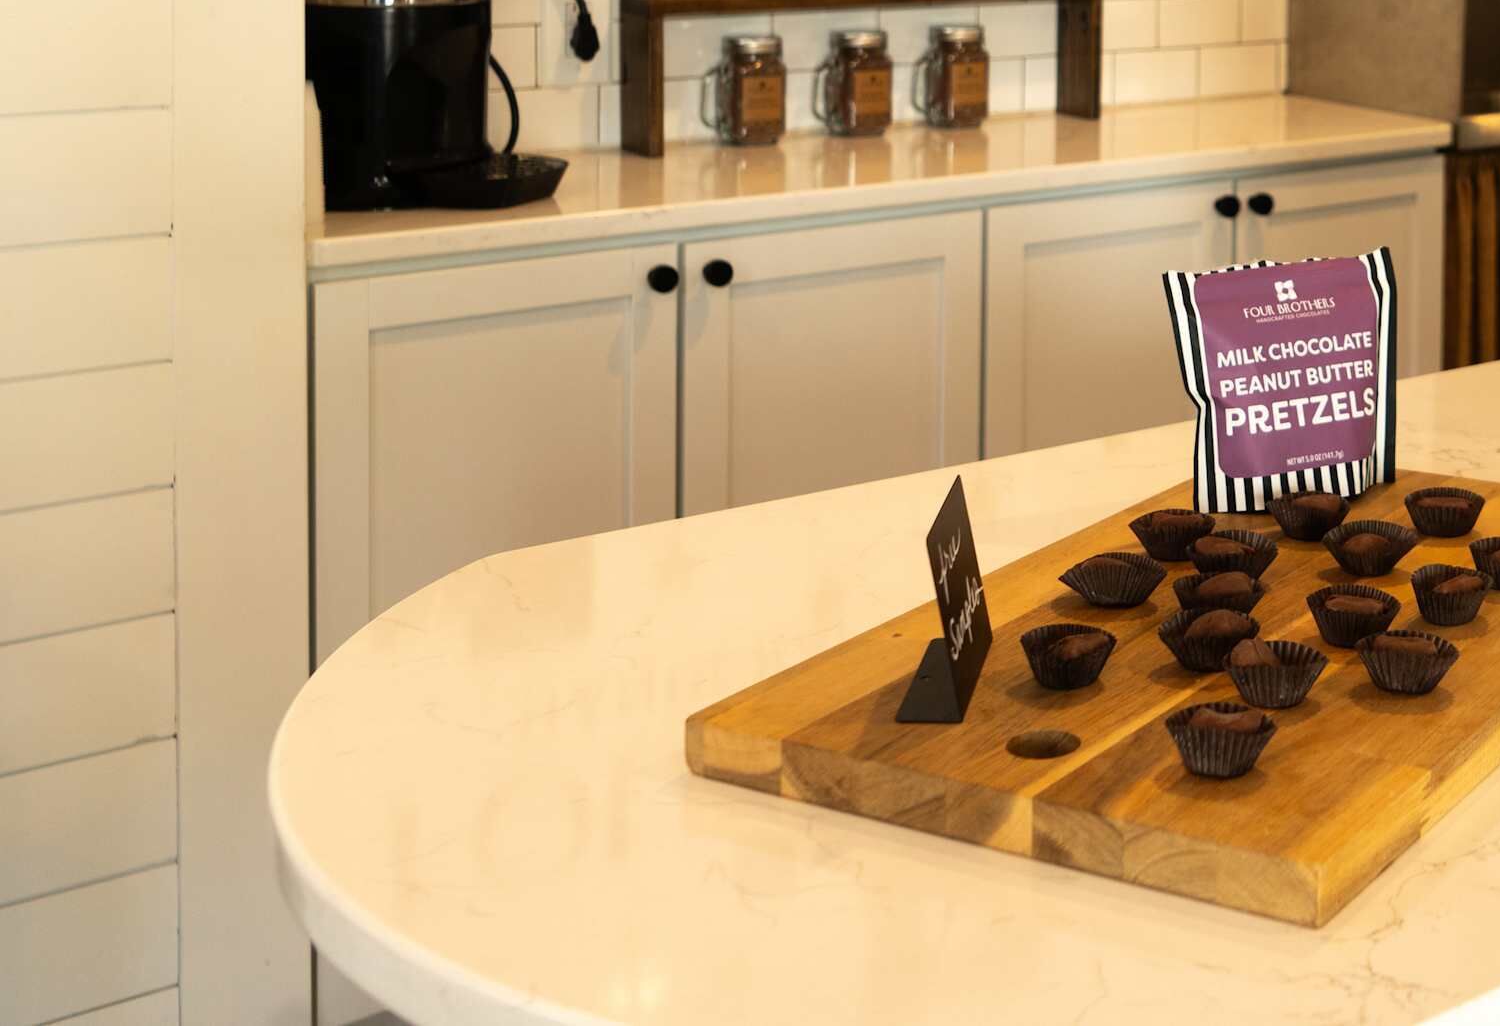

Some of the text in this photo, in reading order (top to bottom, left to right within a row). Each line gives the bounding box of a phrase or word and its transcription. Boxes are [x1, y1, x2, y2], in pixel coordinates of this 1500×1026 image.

[1243, 297, 1336, 319] FOUR BROTHERS
[1217, 331, 1373, 368] MILK CHOCOLATE
[1220, 360, 1374, 398] PEANUT BUTTER
[1225, 387, 1376, 436] PRETZELS
